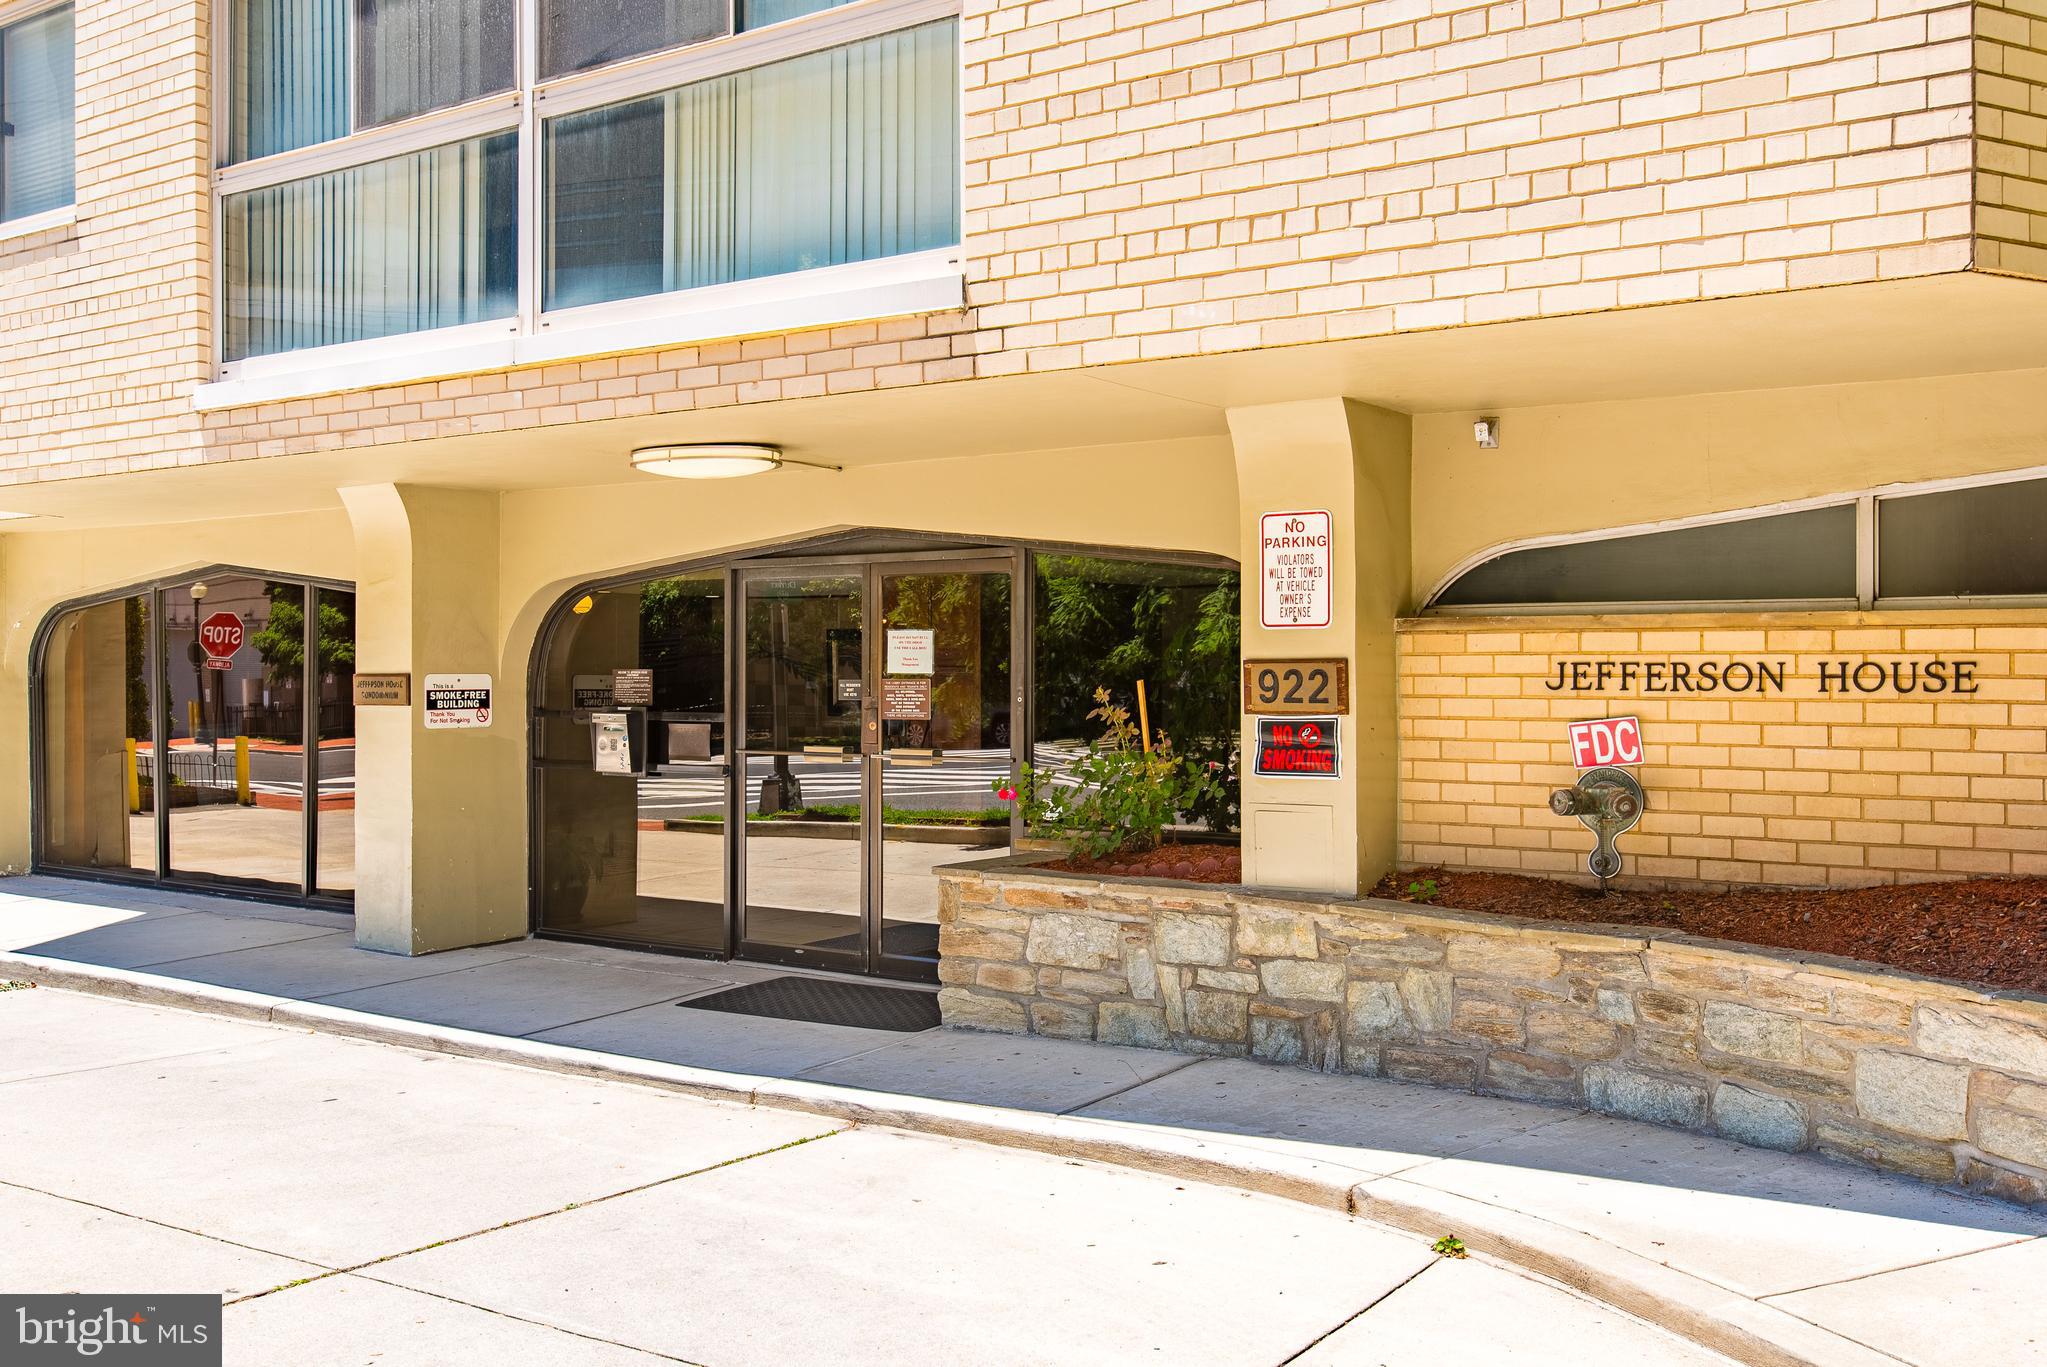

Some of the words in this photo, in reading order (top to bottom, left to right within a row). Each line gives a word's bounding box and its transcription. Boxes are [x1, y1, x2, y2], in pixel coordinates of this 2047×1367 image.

[1285, 521, 1305, 533] NO
[1264, 535, 1327, 548] PARKING
[1277, 553, 1315, 565] VIOLATORS
[1269, 568, 1285, 579] WILL
[1287, 567, 1297, 578] BE
[1300, 567, 1323, 578] TOWED
[1276, 581, 1284, 592] AT
[1287, 580, 1316, 591] VEHICLE
[1280, 593, 1312, 605] OWNER'S
[1280, 606, 1312, 618] EXPENSE
[1545, 661, 1786, 693] JEFFERSON
[1817, 661, 1979, 694] HOUSE
[1258, 668, 1329, 704] 922
[430, 691, 487, 700] SMOKE-FREE
[437, 700, 480, 708] BUILDING
[1272, 724, 1293, 747] NO
[1571, 720, 1639, 766] FDC
[1263, 748, 1332, 772] SMOKING
